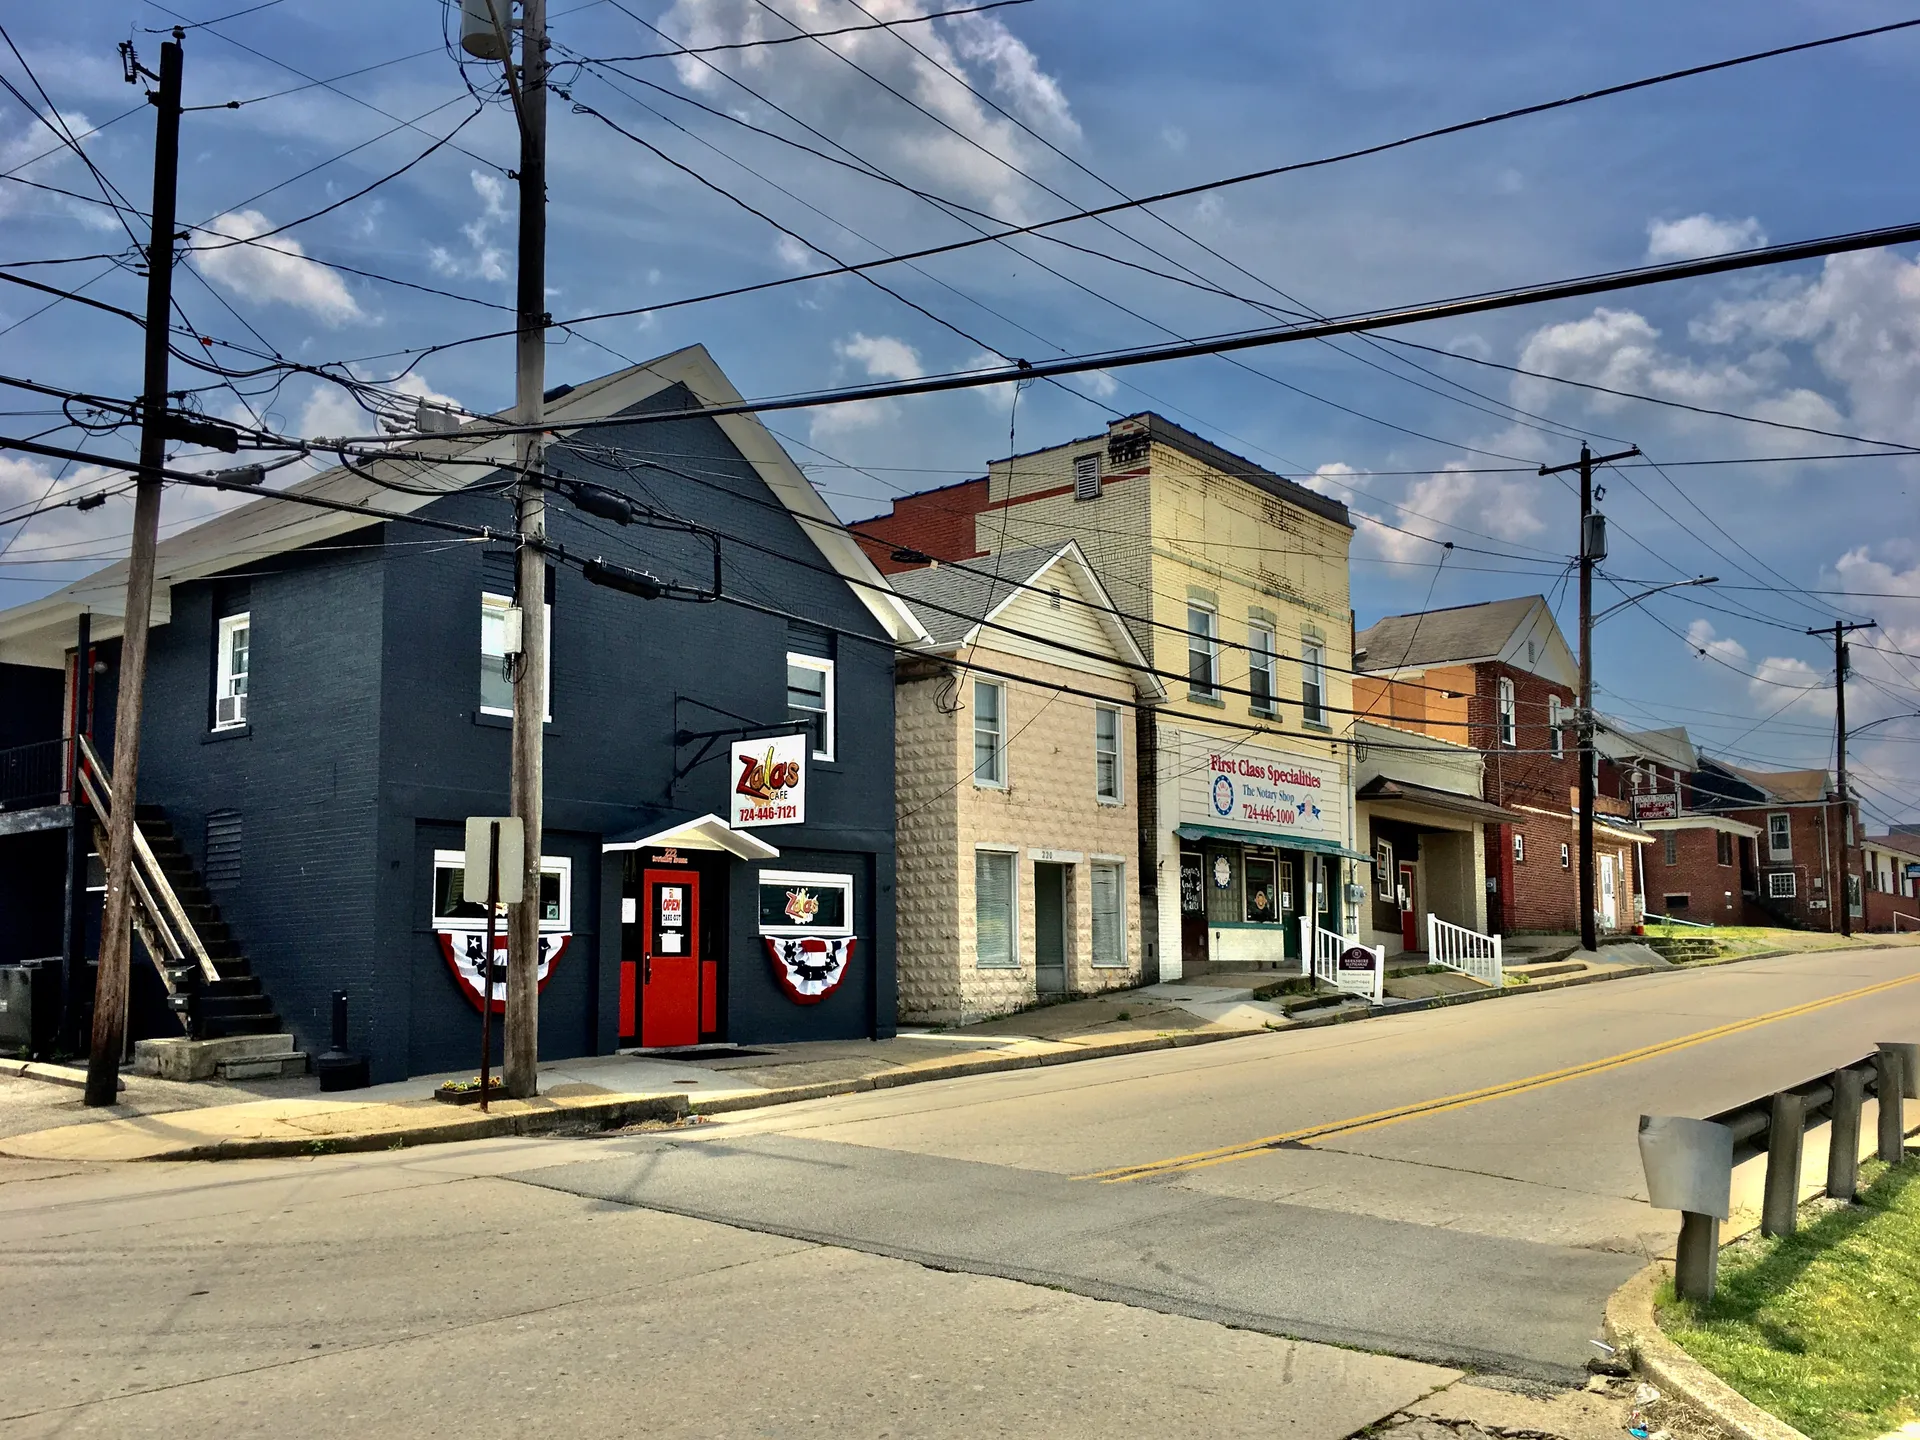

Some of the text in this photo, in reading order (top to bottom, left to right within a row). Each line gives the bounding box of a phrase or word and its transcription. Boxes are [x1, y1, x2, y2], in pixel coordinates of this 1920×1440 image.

[1210, 754, 1321, 788] First Class Specialities
[769, 790, 788, 801] CAFE
[1242, 784, 1255, 797] The
[1256, 786, 1278, 803] Notary
[1279, 789, 1295, 805] Shop
[740, 805, 796, 821] 724-446-7121
[1242, 803, 1295, 825] 724-446-1000
[662, 899, 681, 911] OPEN
